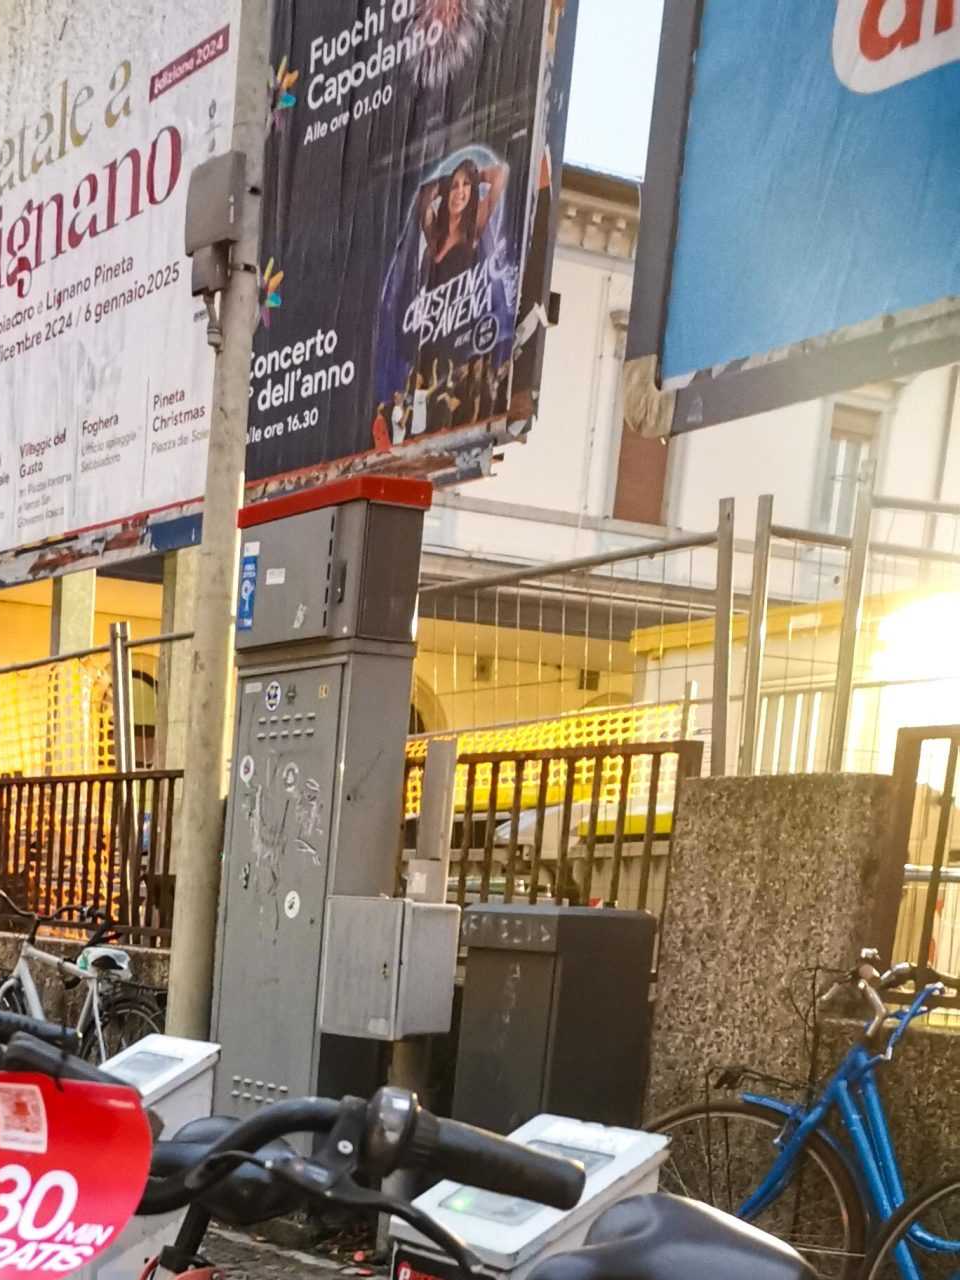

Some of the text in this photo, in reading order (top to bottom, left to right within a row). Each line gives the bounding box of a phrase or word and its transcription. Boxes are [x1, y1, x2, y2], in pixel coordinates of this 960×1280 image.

[309, 0, 386, 74] Fuochi
[307, 19, 443, 110] Capodanno
[104, 59, 132, 128] a
[304, 84, 392, 146] Alle ore 01.00
[46, 275, 91, 311] Lignano
[94, 255, 134, 286] Pineta
[84, 302, 91, 322] 6
[94, 279, 146, 324] gennaio
[146, 261, 180, 296] 2025
[249, 328, 338, 381] oncerto
[153, 389, 185, 412] Pineta
[257, 360, 355, 412] dell'anno
[82, 414, 119, 438] Foghera
[152, 405, 205, 432] Christmas
[264, 422, 284, 439] ore
[287, 407, 319, 432] 16.30
[54, 1221, 114, 1246] MIN
